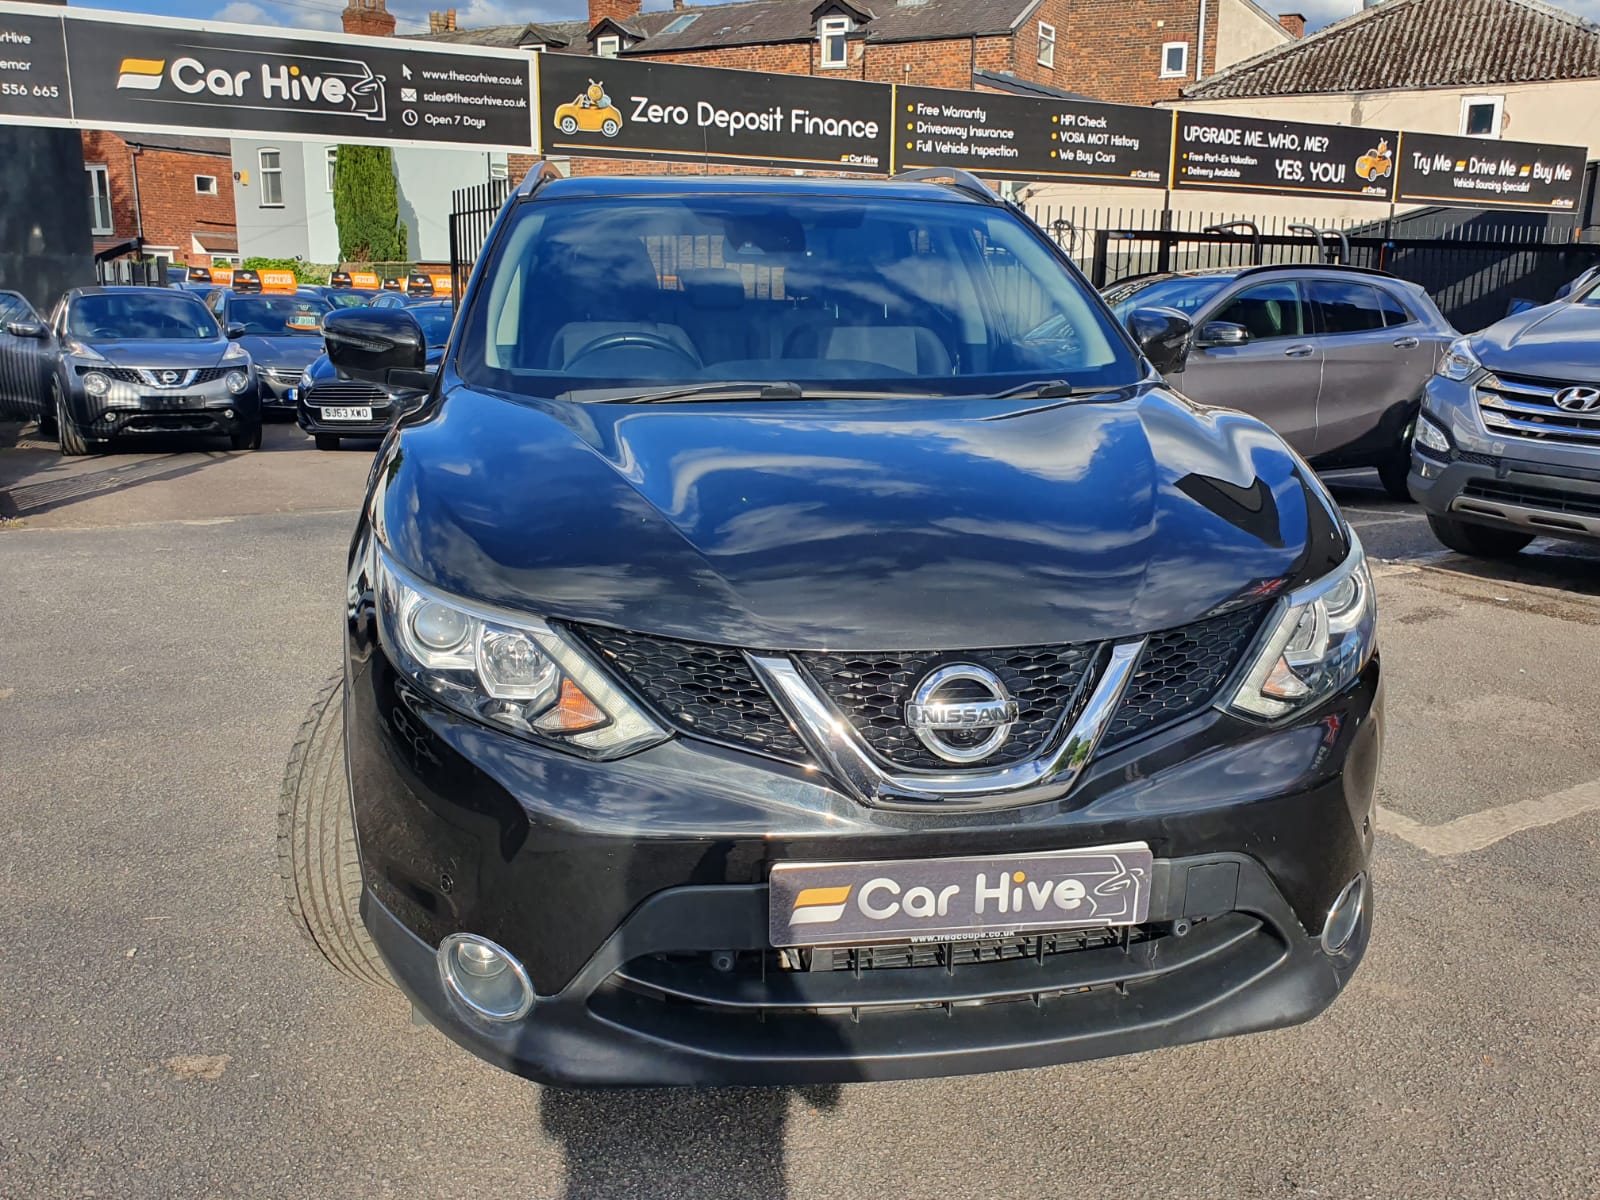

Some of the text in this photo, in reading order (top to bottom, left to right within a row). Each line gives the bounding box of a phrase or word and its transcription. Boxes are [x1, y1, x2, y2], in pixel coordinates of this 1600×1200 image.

[170, 57, 347, 104] Car Hive
[422, 70, 523, 86] www.thecarhive.co.uk
[1, 83, 59, 98] 556 665
[423, 91, 527, 108] sales@thecarhive.co.uk
[424, 113, 486, 129] Open 7 Days
[630, 96, 879, 139] Zero Deposit Finance
[917, 103, 986, 123] Free Warranty
[1060, 114, 1107, 128] HPI Check
[916, 121, 1014, 139] Driveaway Insurance
[1183, 125, 1242, 145] UPGRADE
[1303, 136, 1329, 152] ME?
[916, 140, 1018, 159] Full Vehicle Inspection
[1060, 131, 1139, 151] VOSA MOT History
[849, 154, 879, 166] Car Hive
[1059, 148, 1116, 165] We Buy Cars
[1275, 159, 1346, 184] YES, YOU!
[1412, 152, 1572, 184] Try Me Drive Me Buy Me
[1453, 178, 1475, 188] Vehicle
[921, 705, 1010, 724] NISSAN
[857, 870, 1087, 920] Car Hive
